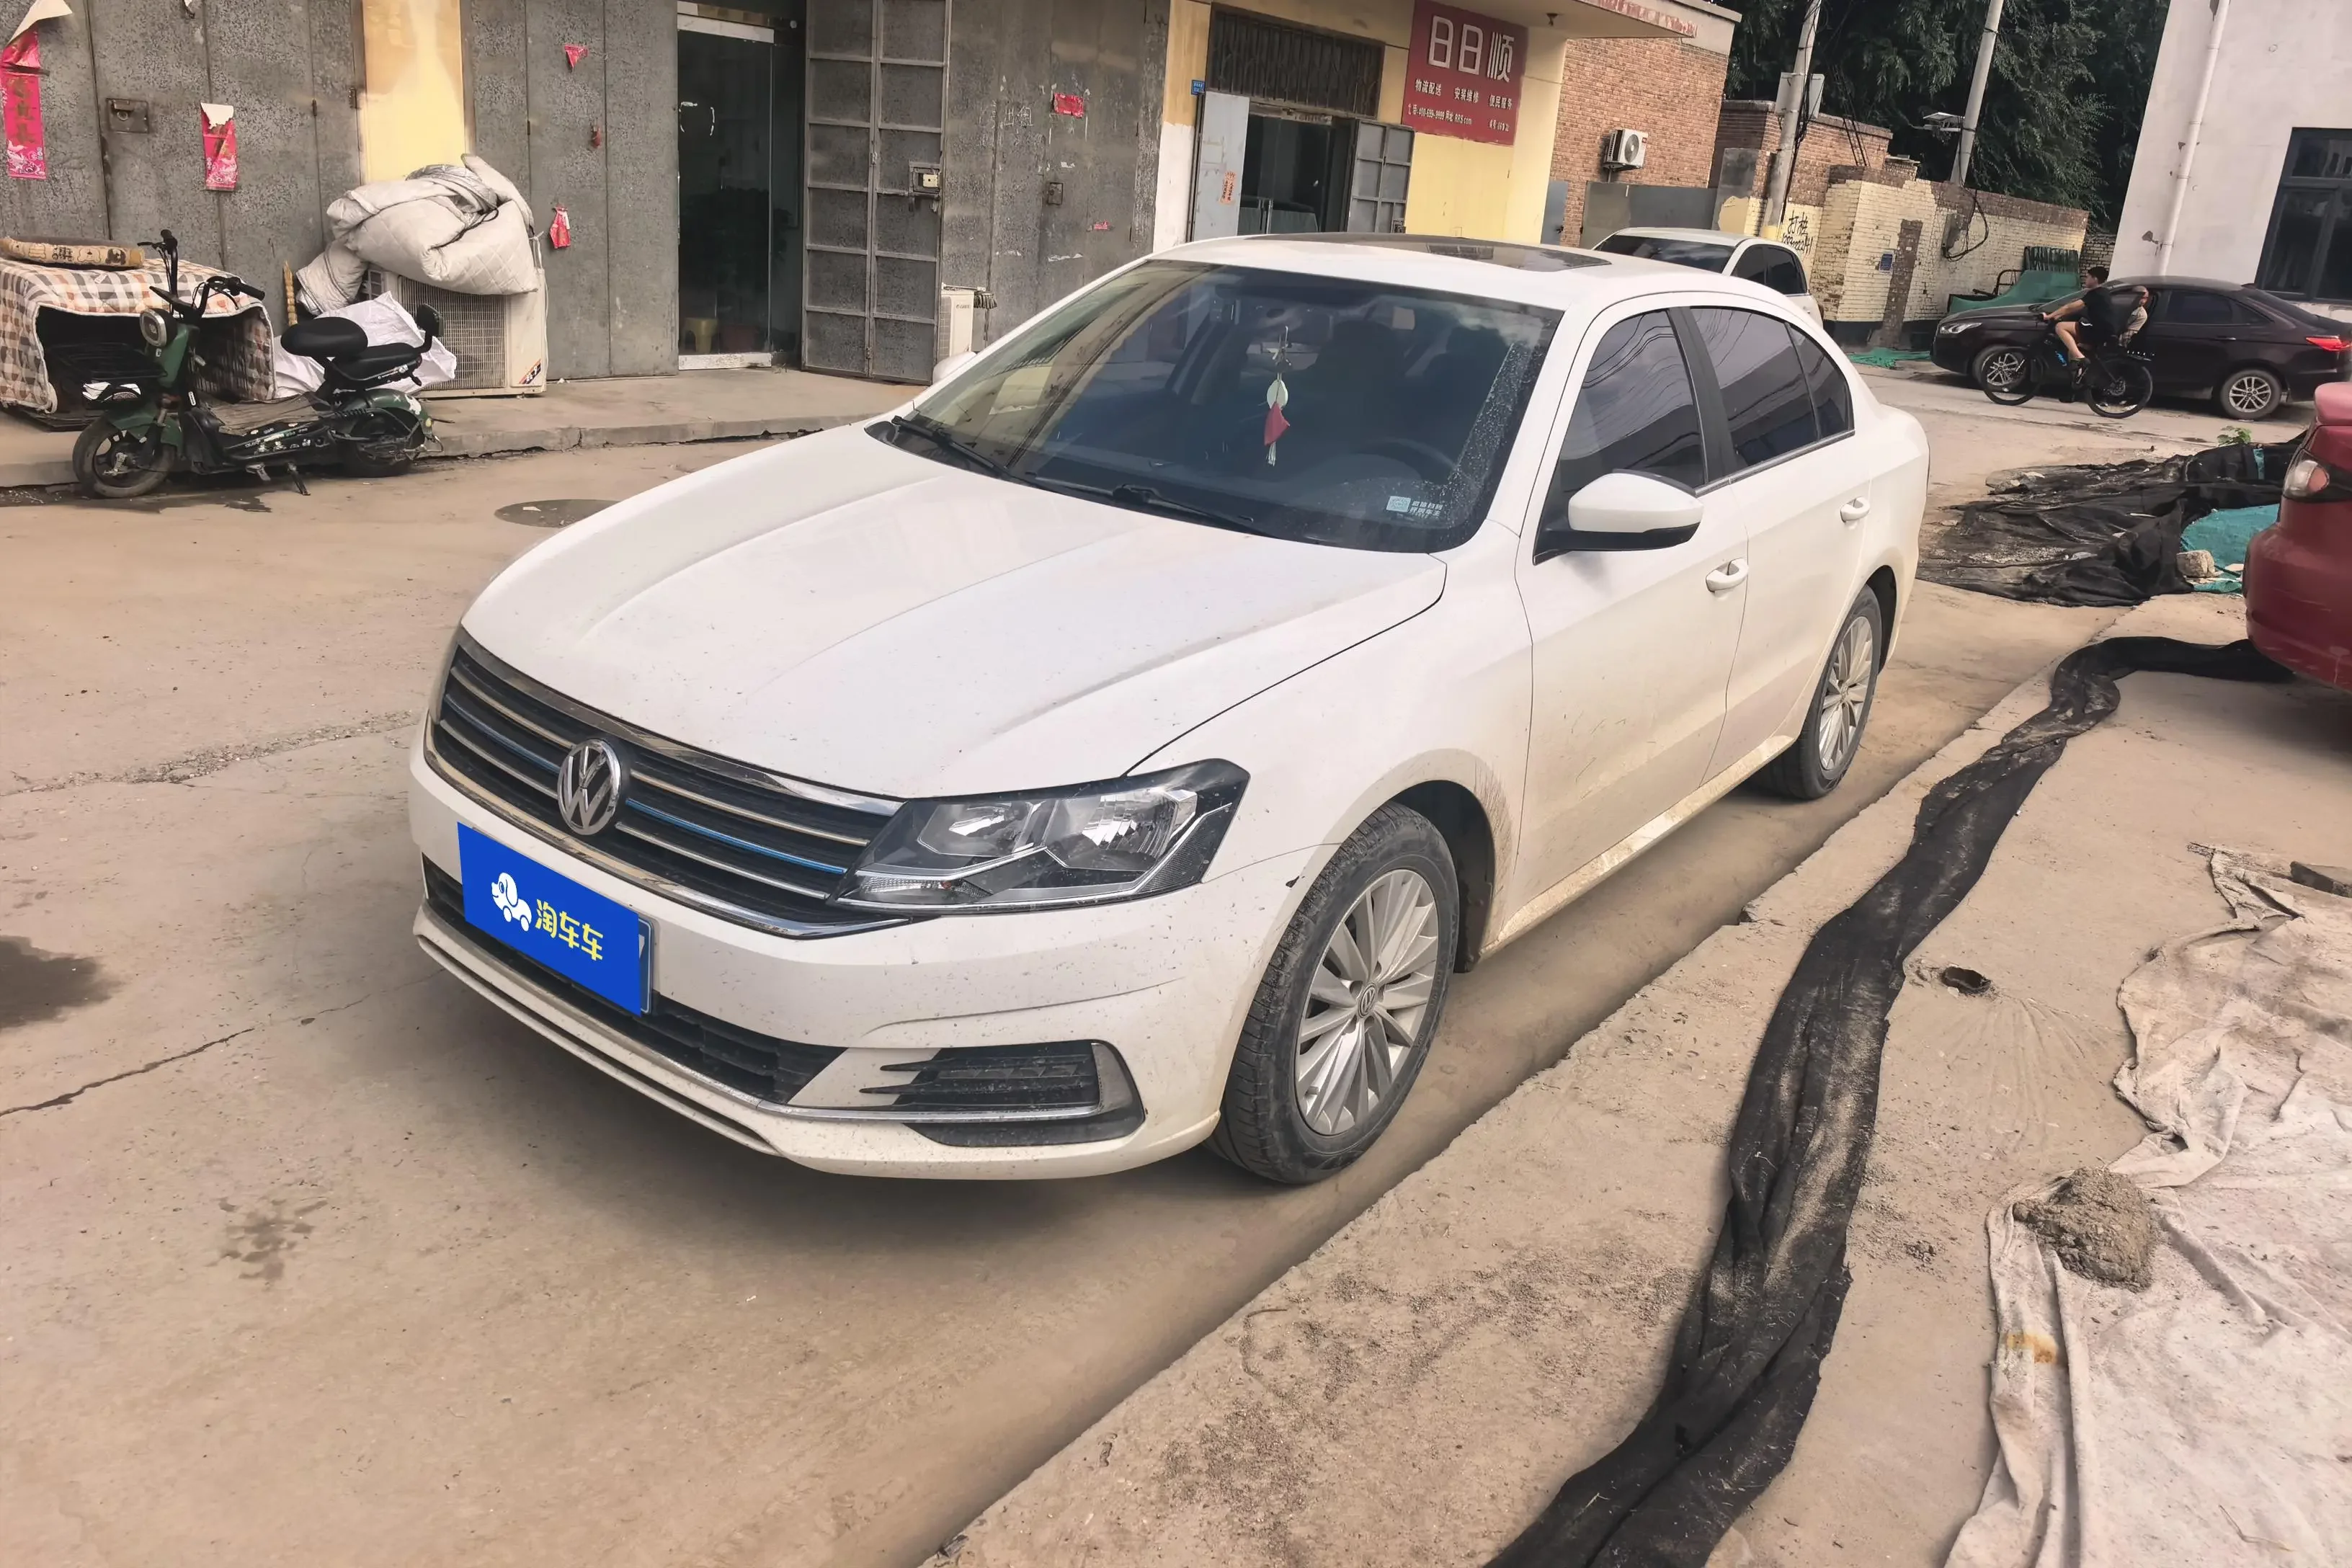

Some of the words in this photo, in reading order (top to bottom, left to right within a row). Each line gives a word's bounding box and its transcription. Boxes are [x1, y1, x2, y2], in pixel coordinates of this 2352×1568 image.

[1428, 15, 1515, 83] 日日顺
[1415, 78, 1442, 97] 物流配送
[1454, 86, 1479, 104] 安装维修
[1489, 94, 1513, 110] 便民服务
